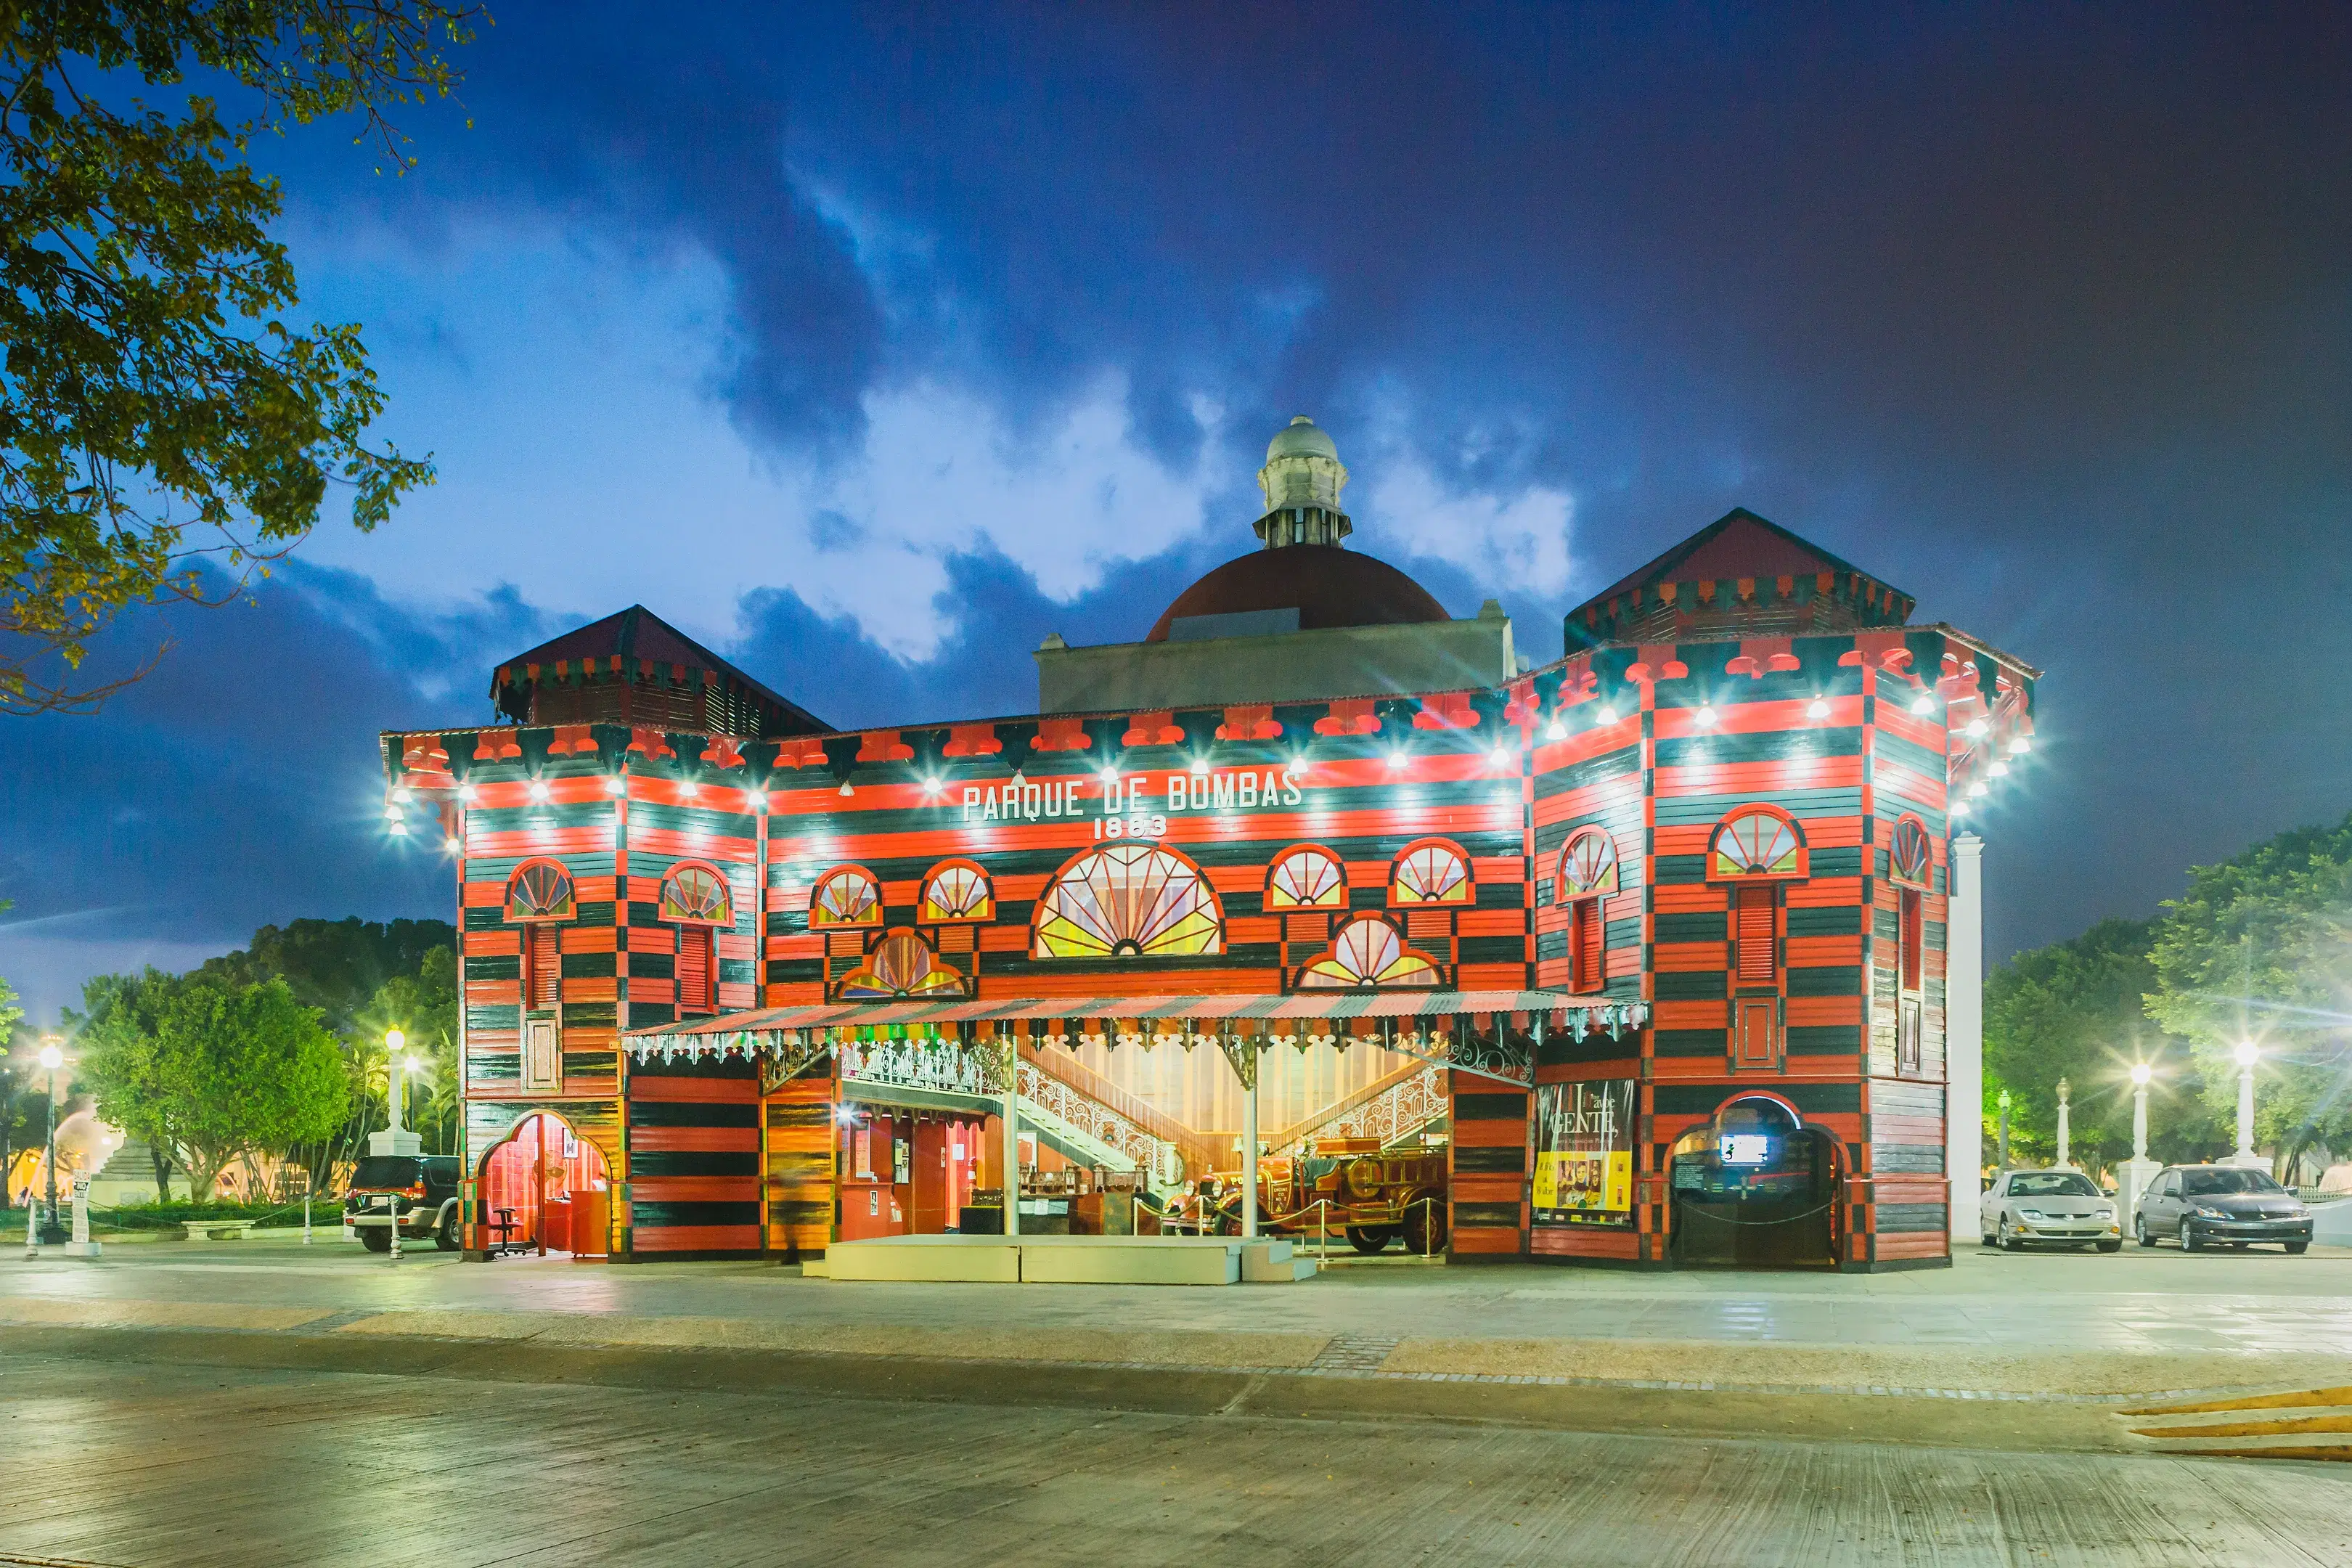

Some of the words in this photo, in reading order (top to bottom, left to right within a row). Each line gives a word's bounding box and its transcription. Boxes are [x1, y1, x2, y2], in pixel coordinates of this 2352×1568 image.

[963, 780, 1084, 822] PARQUE
[1103, 777, 1147, 814] DE
[1168, 770, 1302, 812] BOMBAS
[1094, 814, 1167, 840] 1883
[1230, 1175, 1262, 1185] POE
